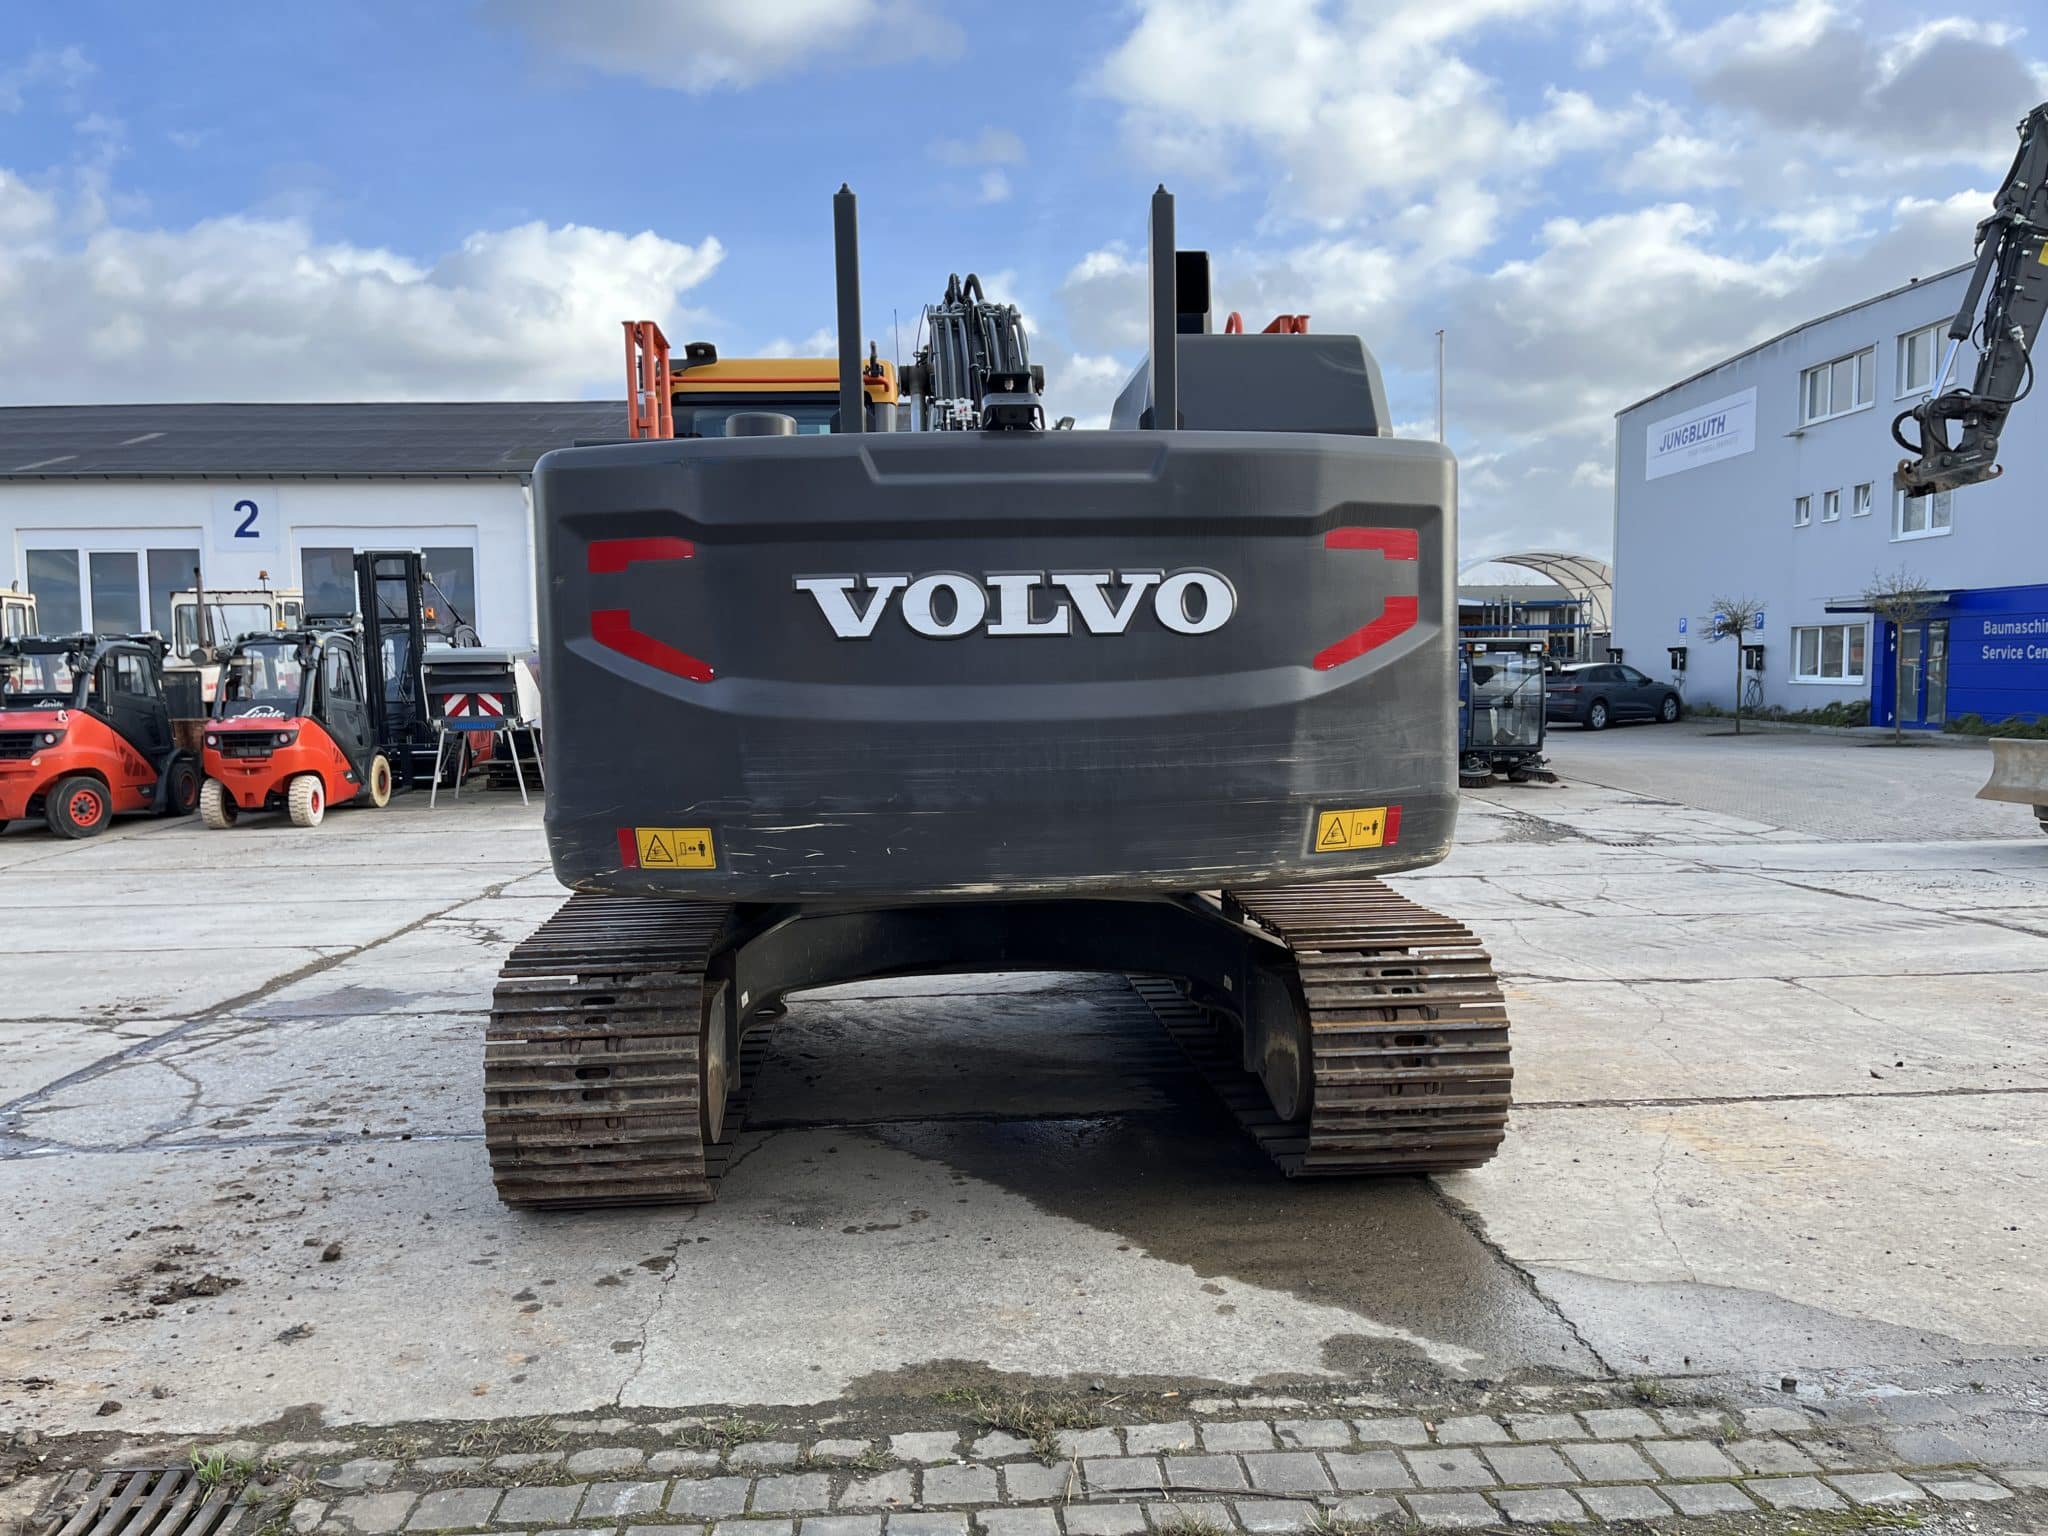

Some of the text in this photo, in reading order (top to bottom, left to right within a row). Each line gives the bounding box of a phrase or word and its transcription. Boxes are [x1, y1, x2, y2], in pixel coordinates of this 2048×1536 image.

[1660, 414, 1726, 452] JUNGBLUTH
[234, 500, 260, 538] 2
[795, 571, 1235, 638] VOLVO
[1982, 645, 2023, 659] Service
[232, 705, 285, 718] Linde
